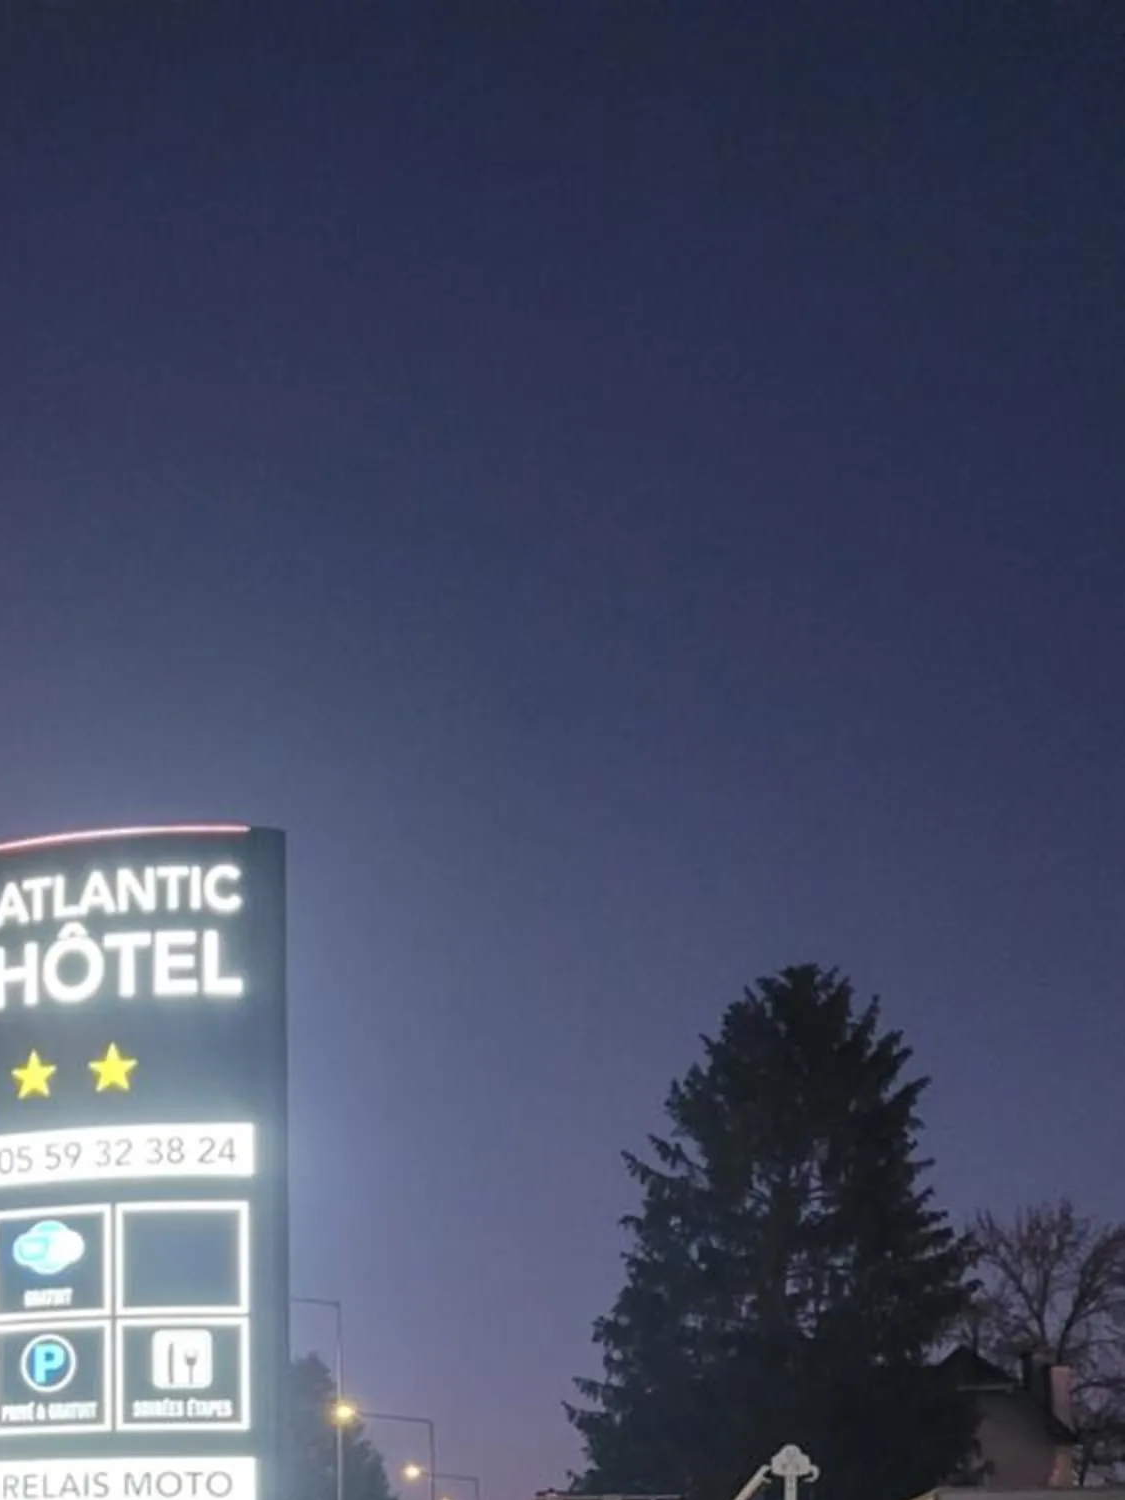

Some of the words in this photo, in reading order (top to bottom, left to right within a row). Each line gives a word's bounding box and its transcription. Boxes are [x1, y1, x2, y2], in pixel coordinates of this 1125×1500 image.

[44, 1141, 82, 1169] 59
[94, 1138, 133, 1168] 32
[146, 1136, 186, 1166] 38
[197, 1136, 237, 1165] 24
[1, 1470, 110, 1499] RELAIS
[124, 1470, 233, 1498] MOTO
